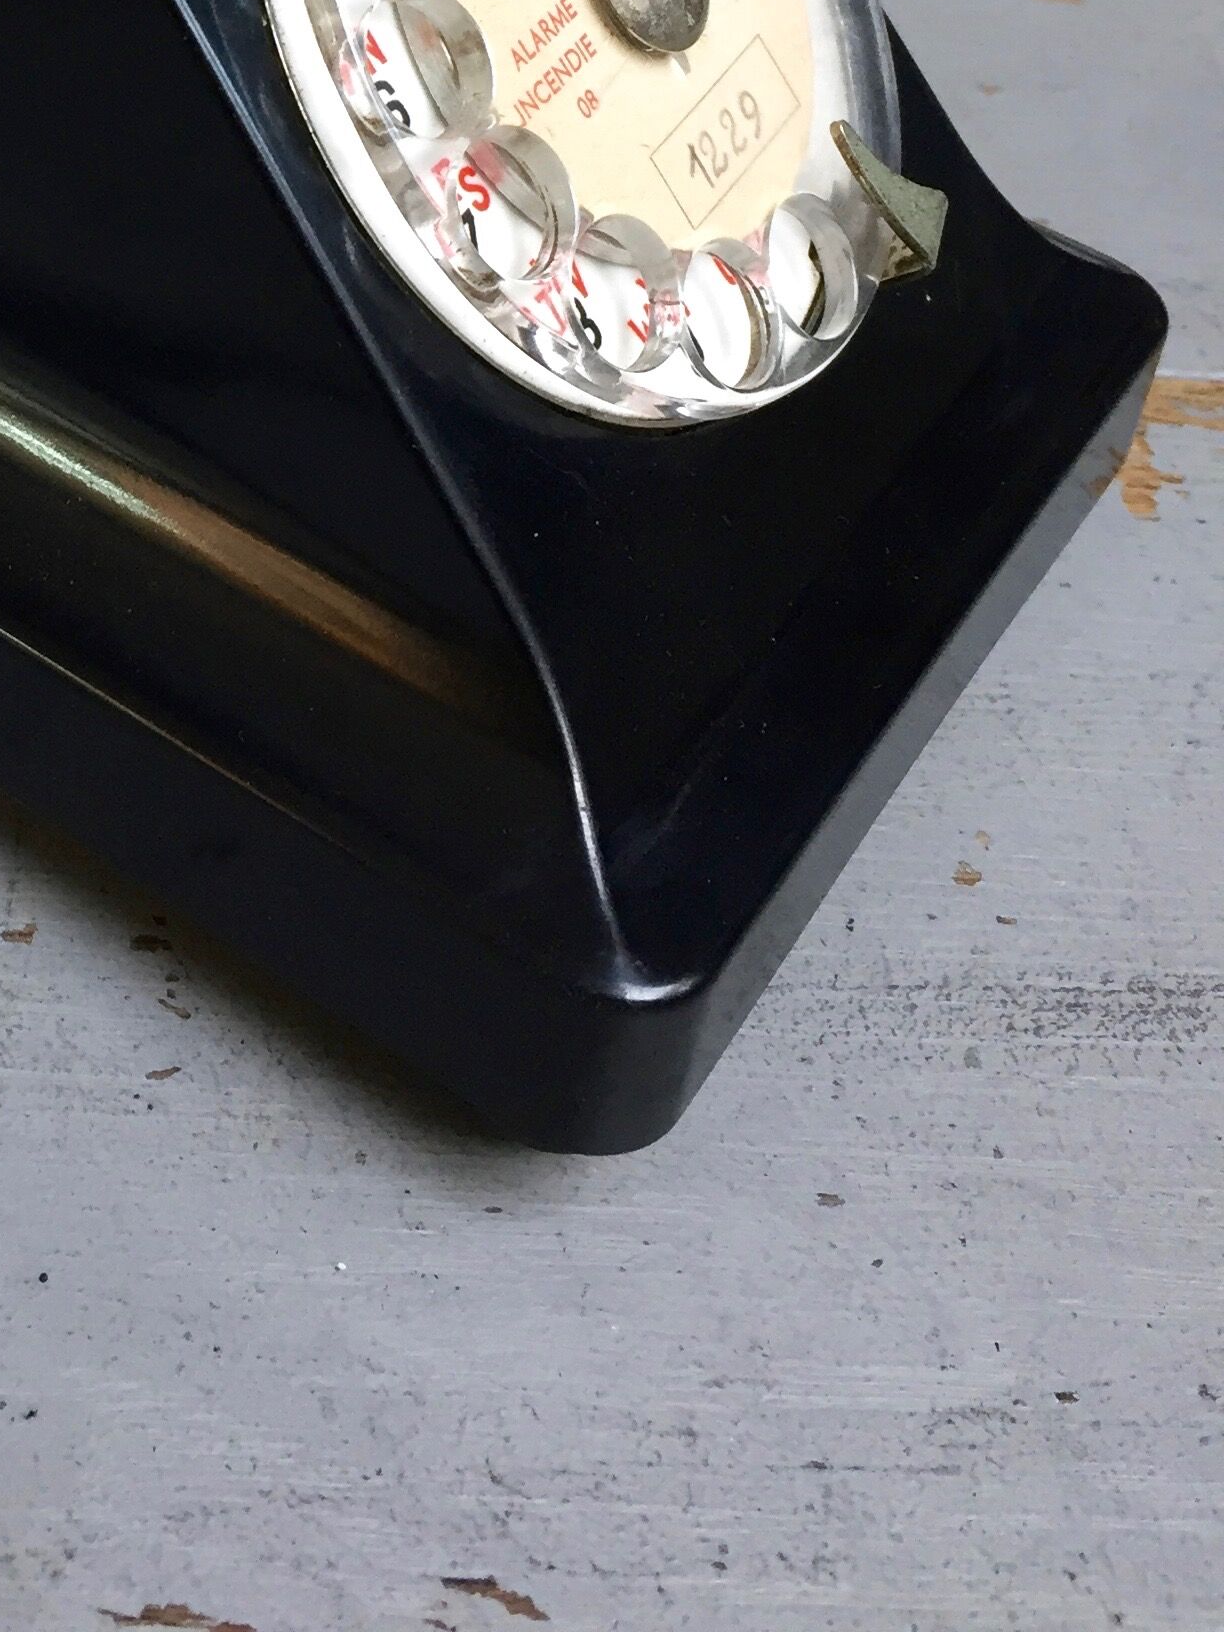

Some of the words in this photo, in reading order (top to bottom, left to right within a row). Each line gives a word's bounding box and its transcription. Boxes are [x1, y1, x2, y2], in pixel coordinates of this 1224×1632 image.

[576, 89, 600, 118] 08
[687, 90, 762, 189] 1229
[457, 166, 491, 212] S
